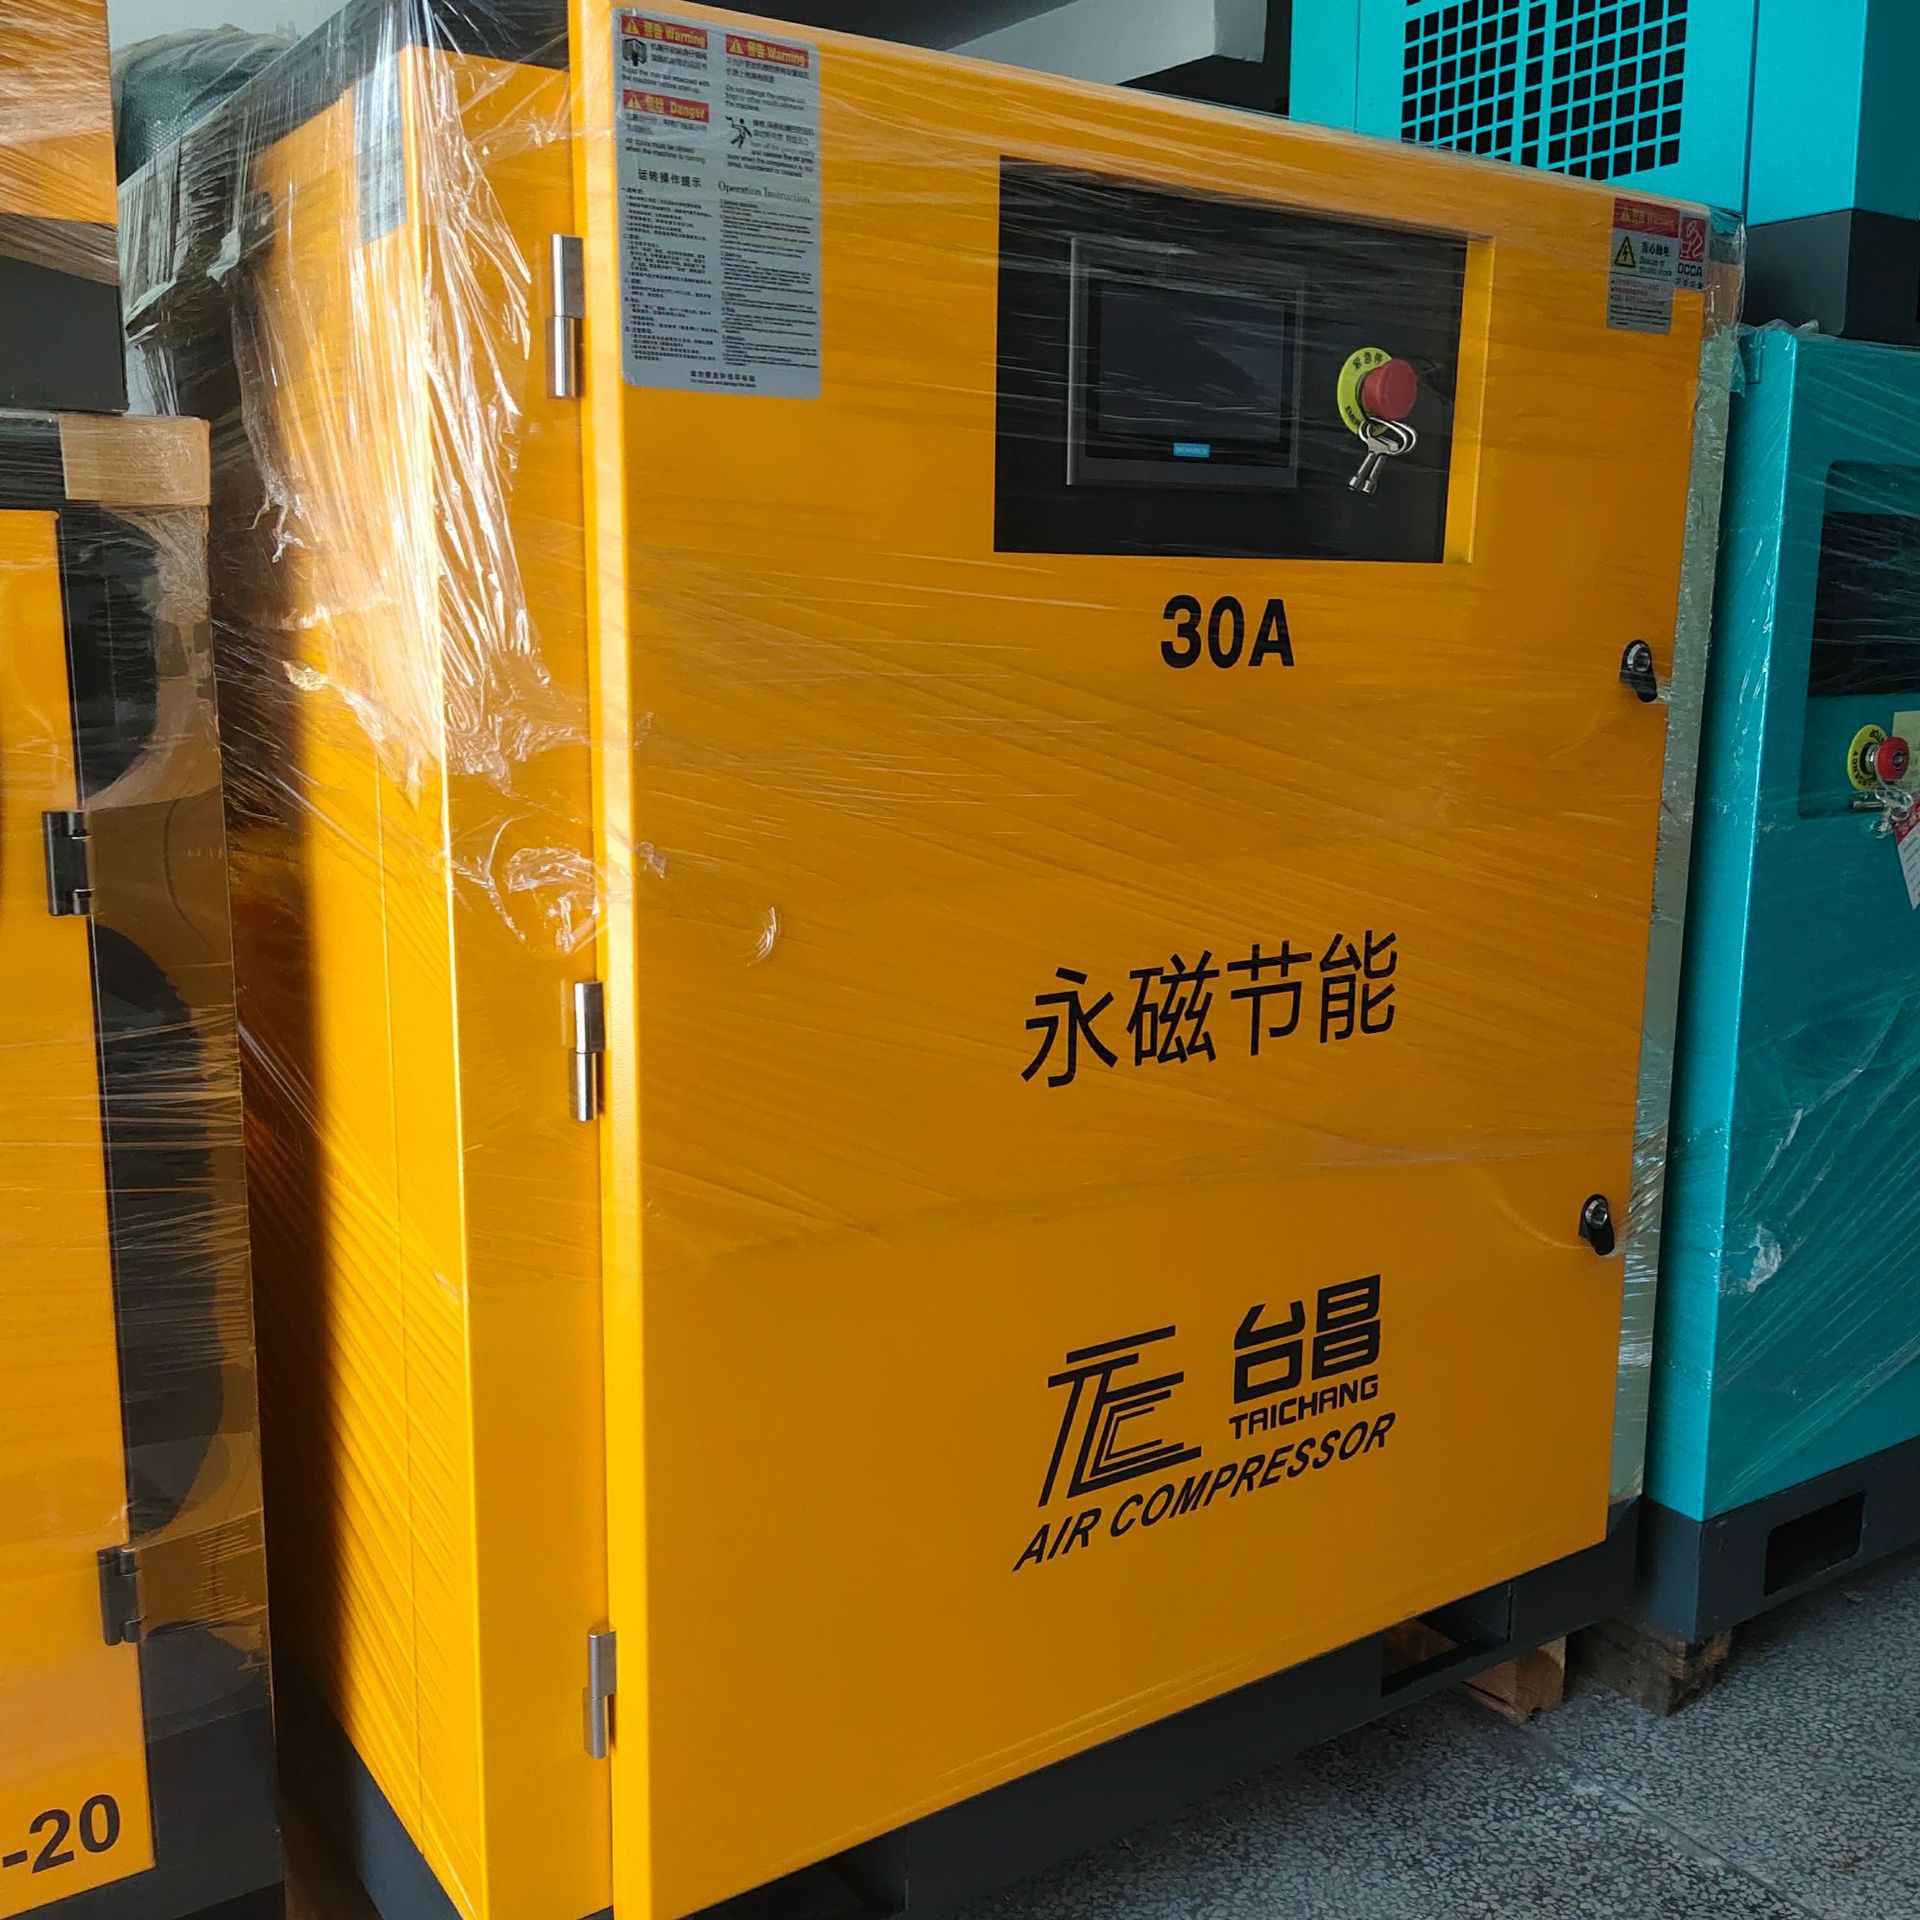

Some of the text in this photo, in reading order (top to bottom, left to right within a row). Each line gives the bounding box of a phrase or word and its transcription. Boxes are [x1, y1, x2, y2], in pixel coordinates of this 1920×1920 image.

[664, 25, 706, 47] Warning
[767, 45, 806, 67] Warning
[669, 101, 705, 120] Danger
[718, 180, 810, 204] Operation Instruction
[1161, 595, 1294, 669] 30A
[1022, 930, 1397, 1088] 永磁节能
[1234, 1275, 1380, 1404] 台昌
[1229, 1374, 1379, 1439] TAICHANG
[1013, 1413, 1395, 1571] AIR COMPRESSOR
[2, 1794, 120, 1873] -20
